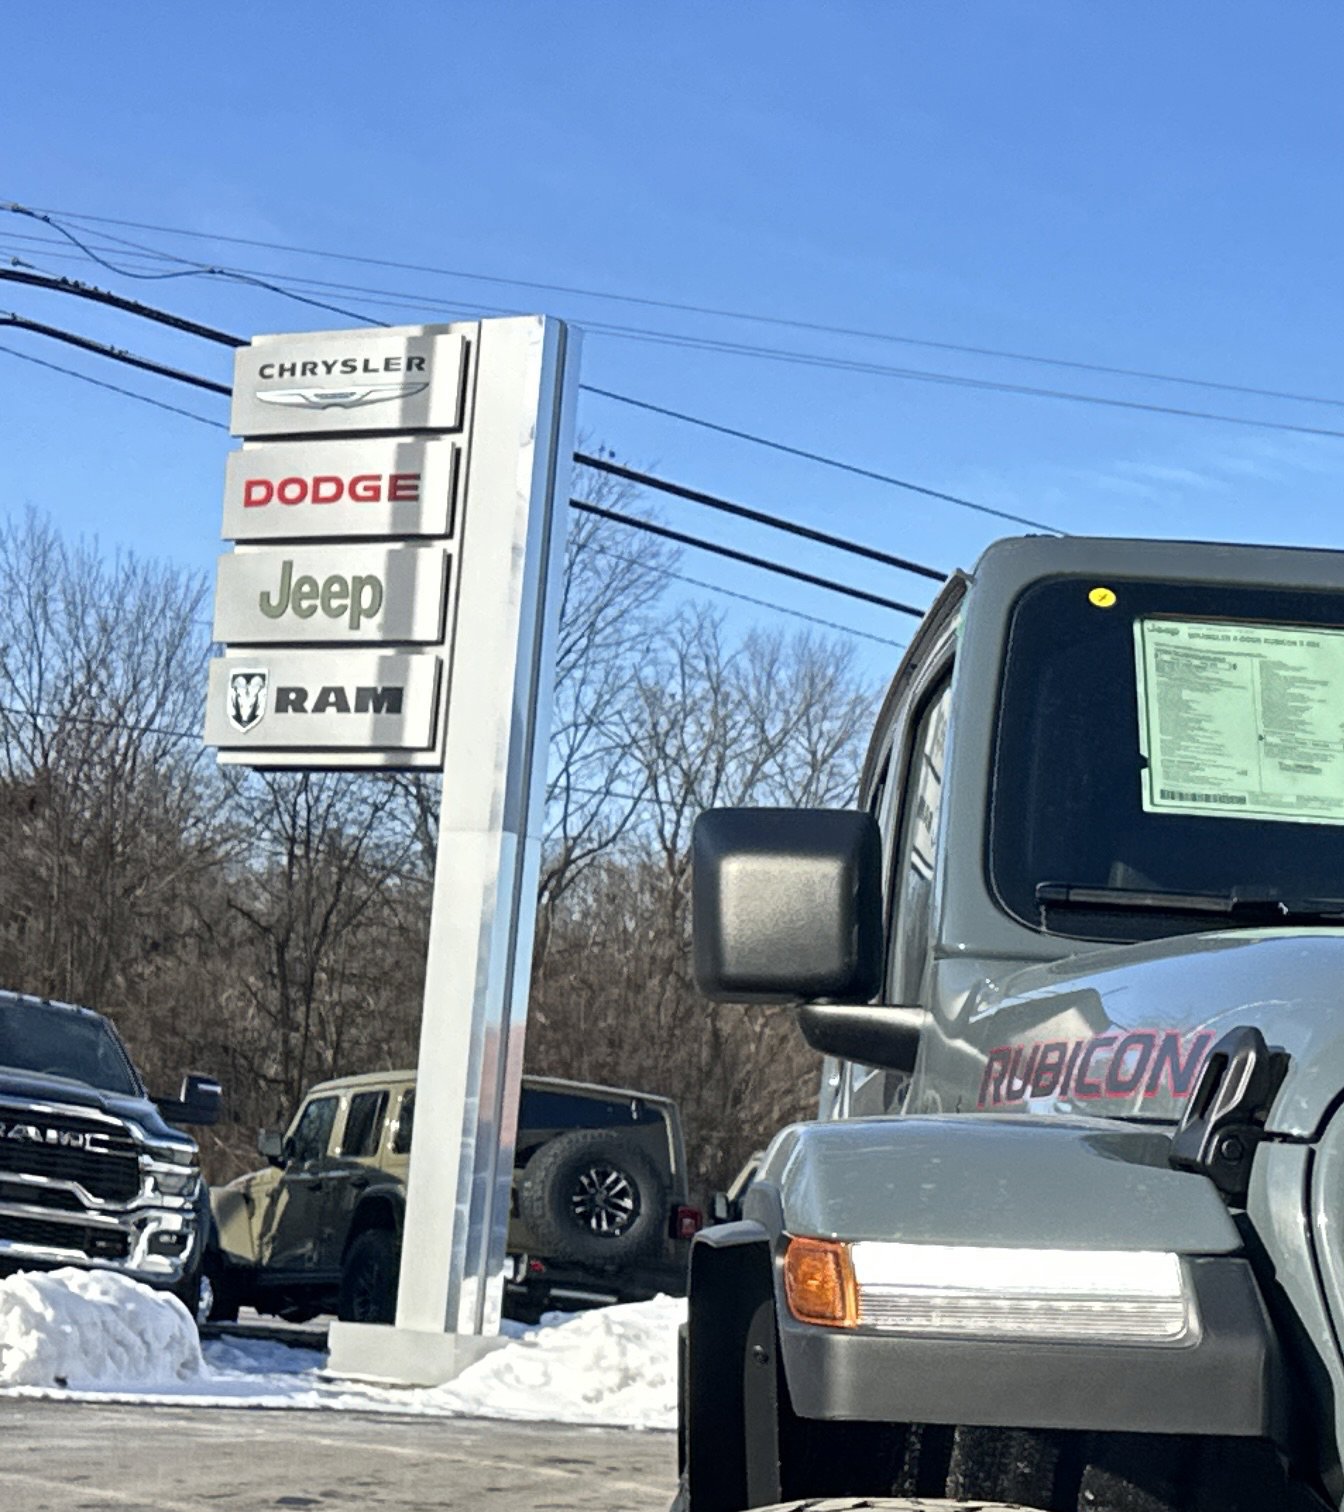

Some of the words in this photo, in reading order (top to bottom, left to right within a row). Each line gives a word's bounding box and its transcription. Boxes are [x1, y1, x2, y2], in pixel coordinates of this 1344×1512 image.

[258, 356, 427, 380] CHRYSLER
[243, 474, 421, 508] DODGE
[258, 560, 384, 631] Jeep
[274, 686, 404, 714] RAM
[977, 1029, 1216, 1110] RUBICON
